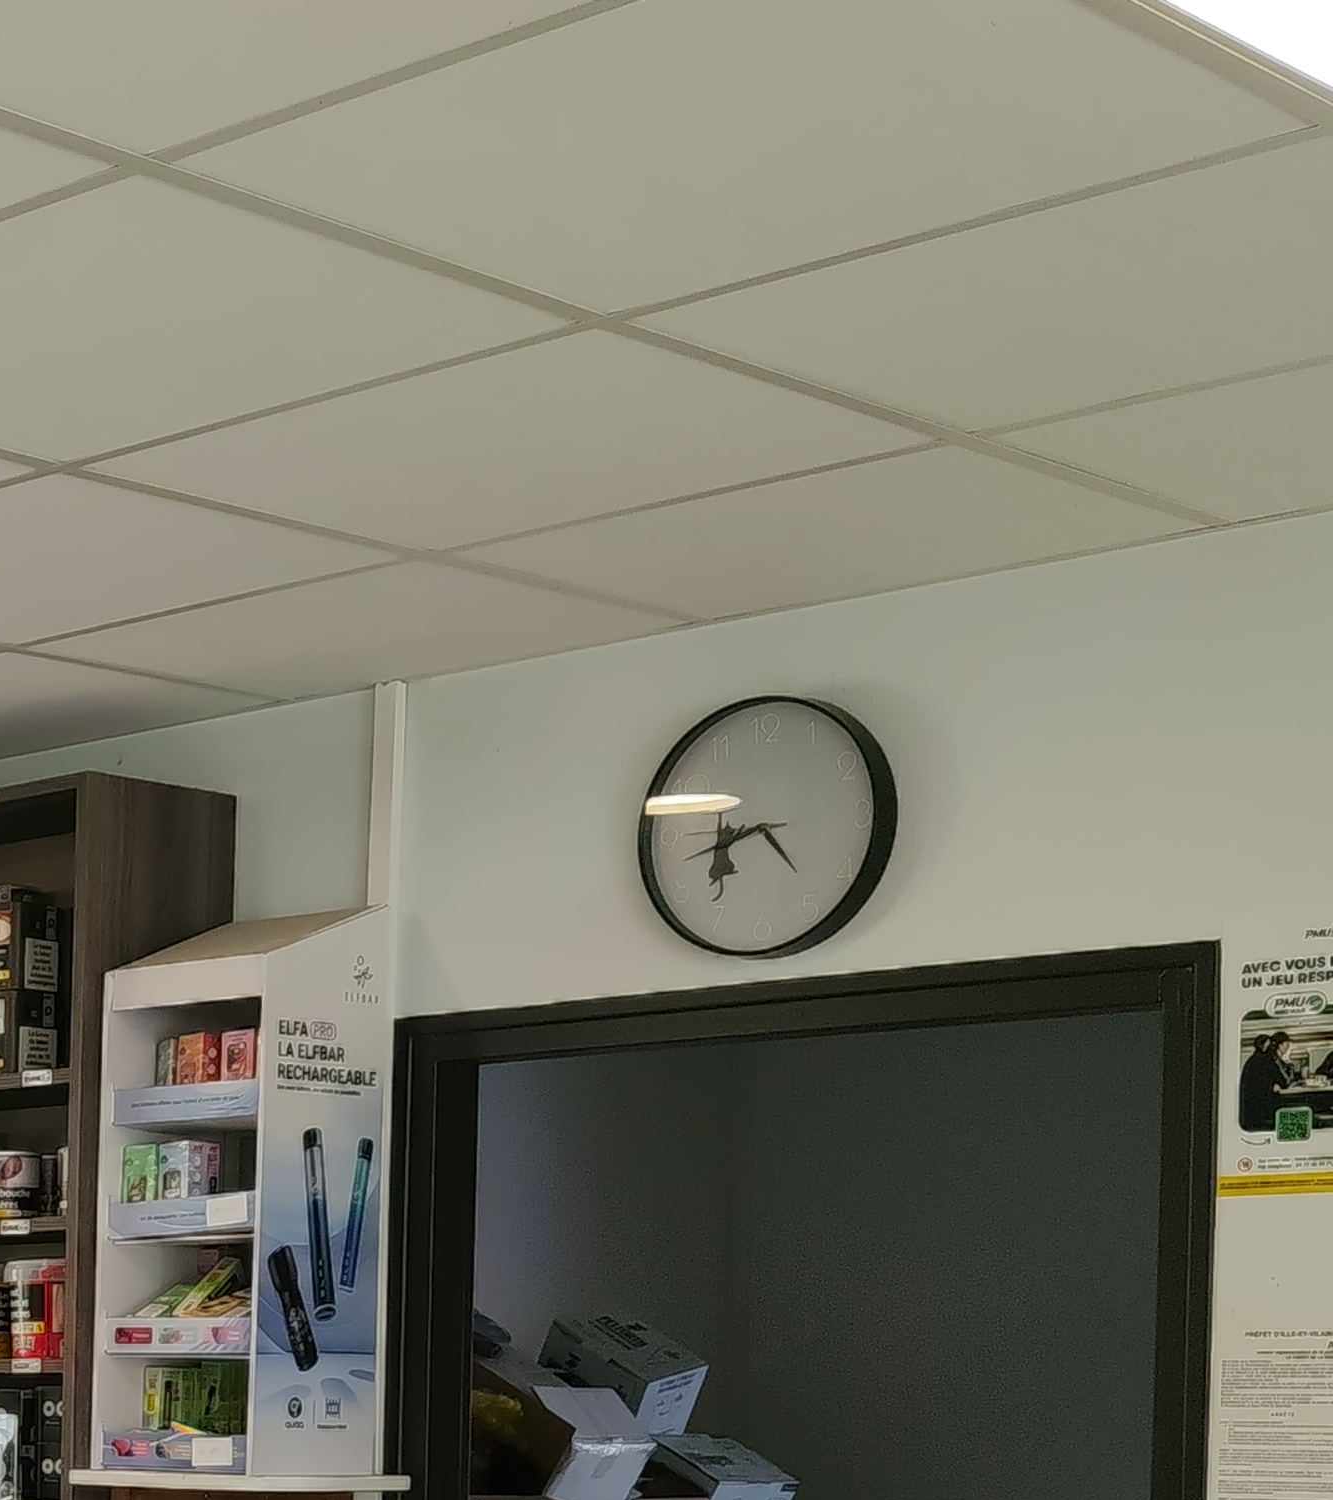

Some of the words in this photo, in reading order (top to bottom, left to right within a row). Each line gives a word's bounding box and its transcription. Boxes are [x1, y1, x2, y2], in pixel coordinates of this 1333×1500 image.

[1242, 961, 1281, 974] AVEC
[1285, 957, 1325, 970] VOUS
[1242, 977, 1262, 988] UN
[1266, 974, 1293, 986] JEU
[1274, 997, 1305, 1008] PMU
[278, 1019, 308, 1037] ELFA
[312, 1023, 333, 1037] PRO
[278, 1041, 294, 1058] LA
[297, 1043, 345, 1062] ELFBAR
[277, 1063, 377, 1087] RECHARGEABLE
[0, 1189, 31, 1198] bouche
